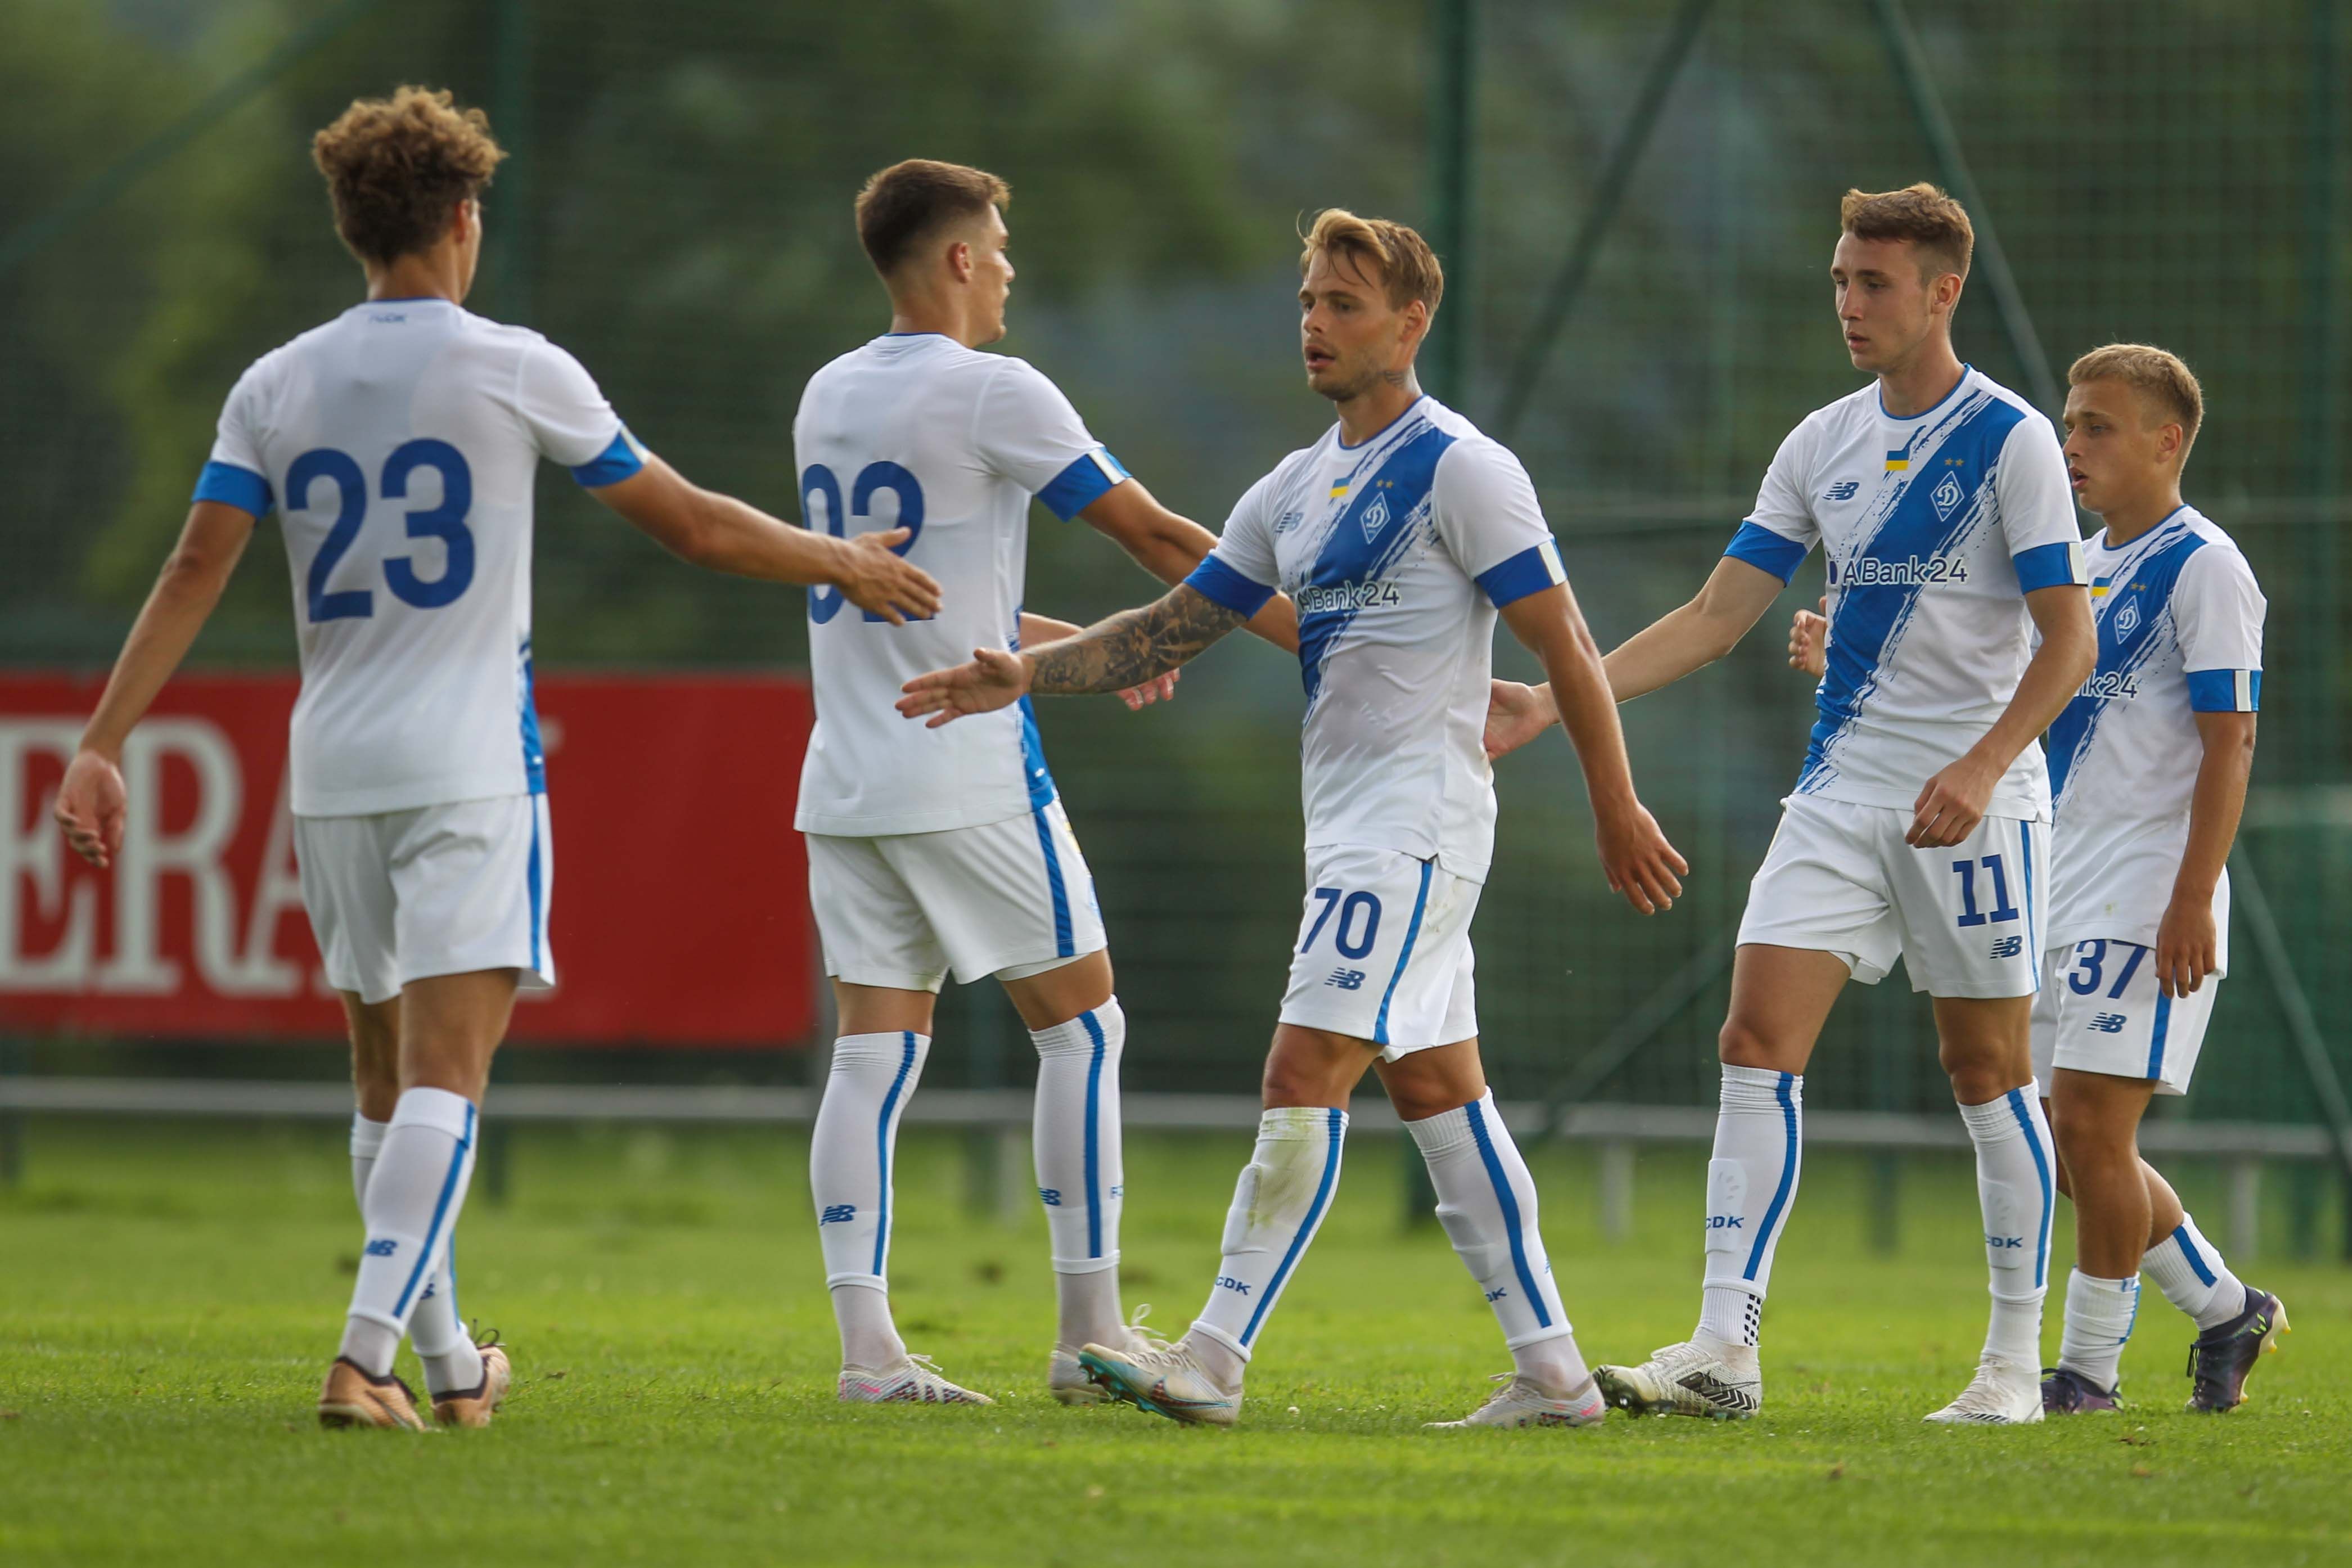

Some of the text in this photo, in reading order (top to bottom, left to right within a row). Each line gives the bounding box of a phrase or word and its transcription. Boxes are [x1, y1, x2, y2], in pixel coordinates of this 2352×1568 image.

[286, 438, 476, 623] 23
[1843, 555, 1968, 585] ABank24
[1300, 887, 1382, 959] 70
[1952, 854, 2019, 927] 11
[2068, 939, 2148, 999] 37
